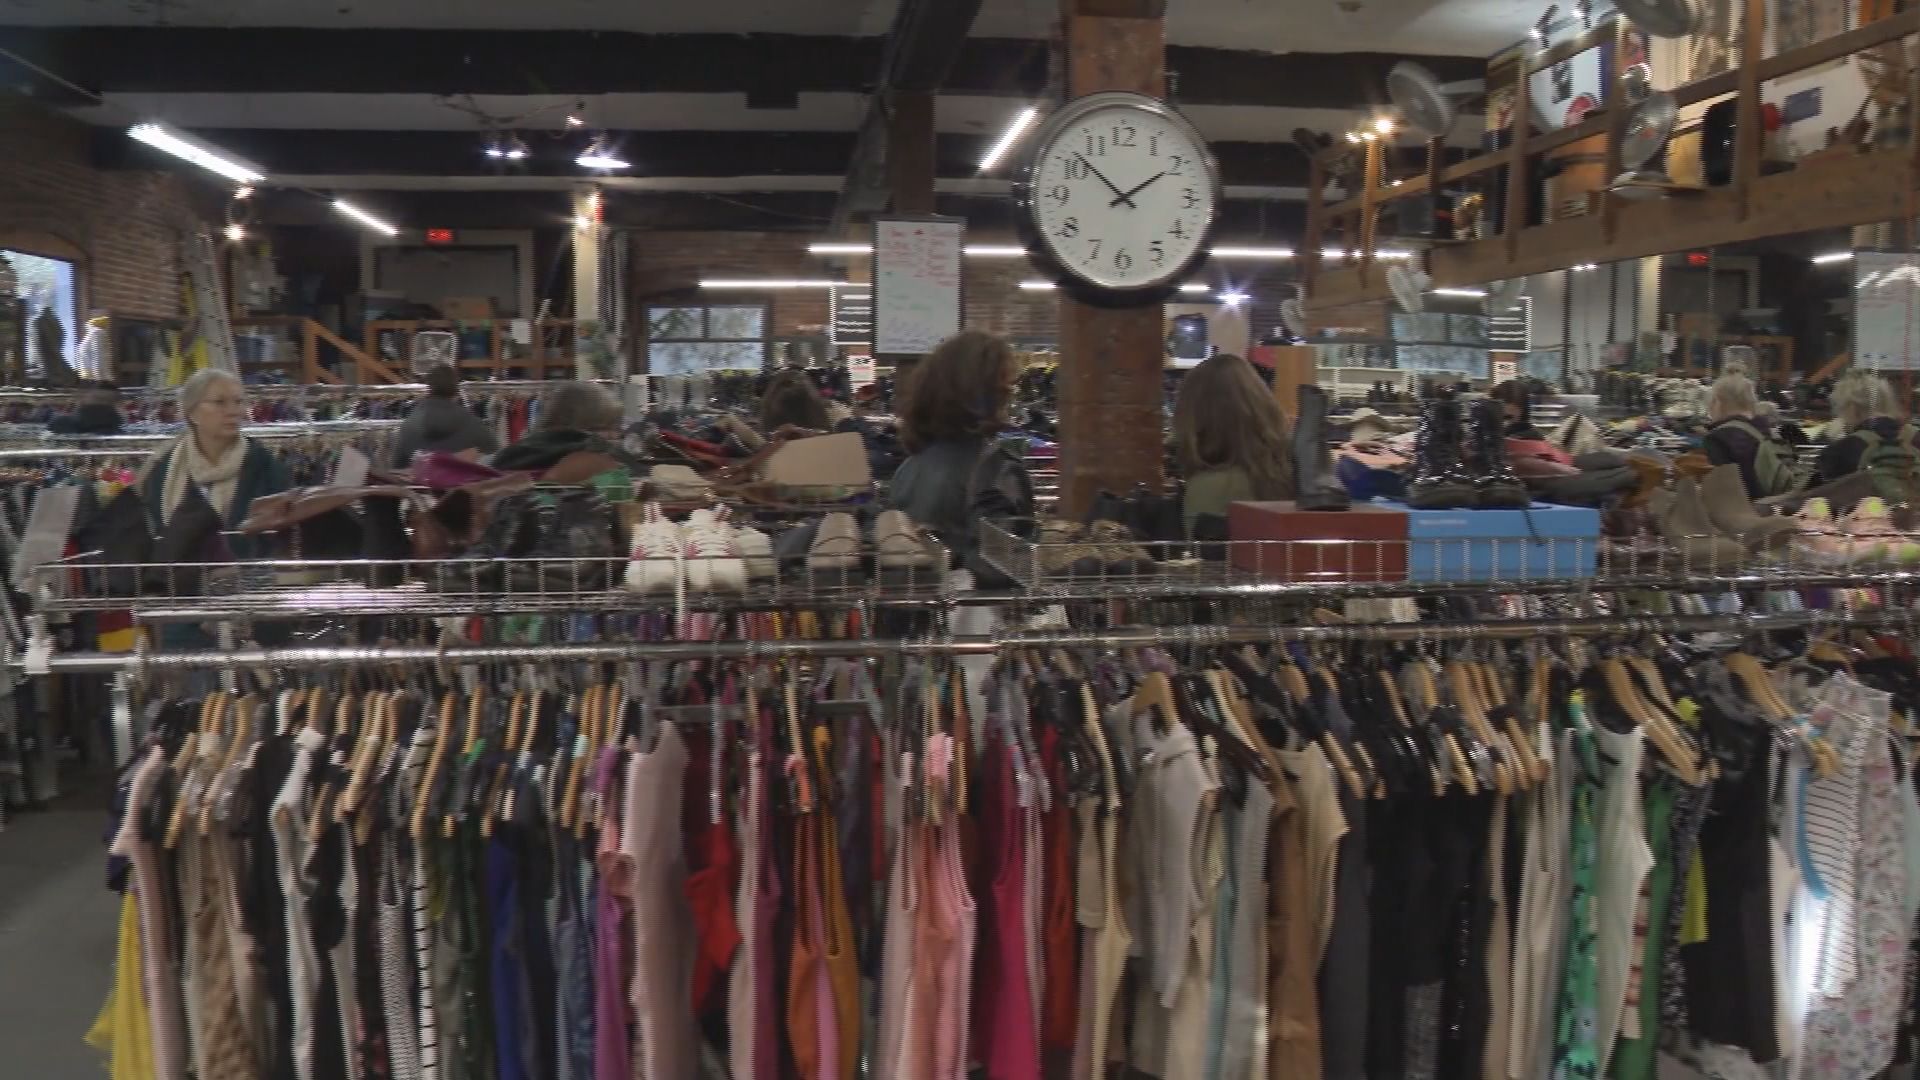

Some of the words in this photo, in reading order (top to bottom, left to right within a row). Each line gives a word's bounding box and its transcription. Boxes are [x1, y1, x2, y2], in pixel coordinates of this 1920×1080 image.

[1086, 135, 1105, 156] 11
[1112, 126, 1137, 147] 12
[1150, 135, 1157, 156] 1
[1064, 158, 1089, 180] 10
[1166, 155, 1183, 176] 2
[1051, 185, 1070, 207] 9
[1182, 188, 1197, 209] 3
[1063, 217, 1080, 238] 8
[1167, 219, 1183, 240] 4
[1088, 238, 1102, 260] 7
[1114, 248, 1132, 270] 6
[1149, 240, 1165, 263] 5
